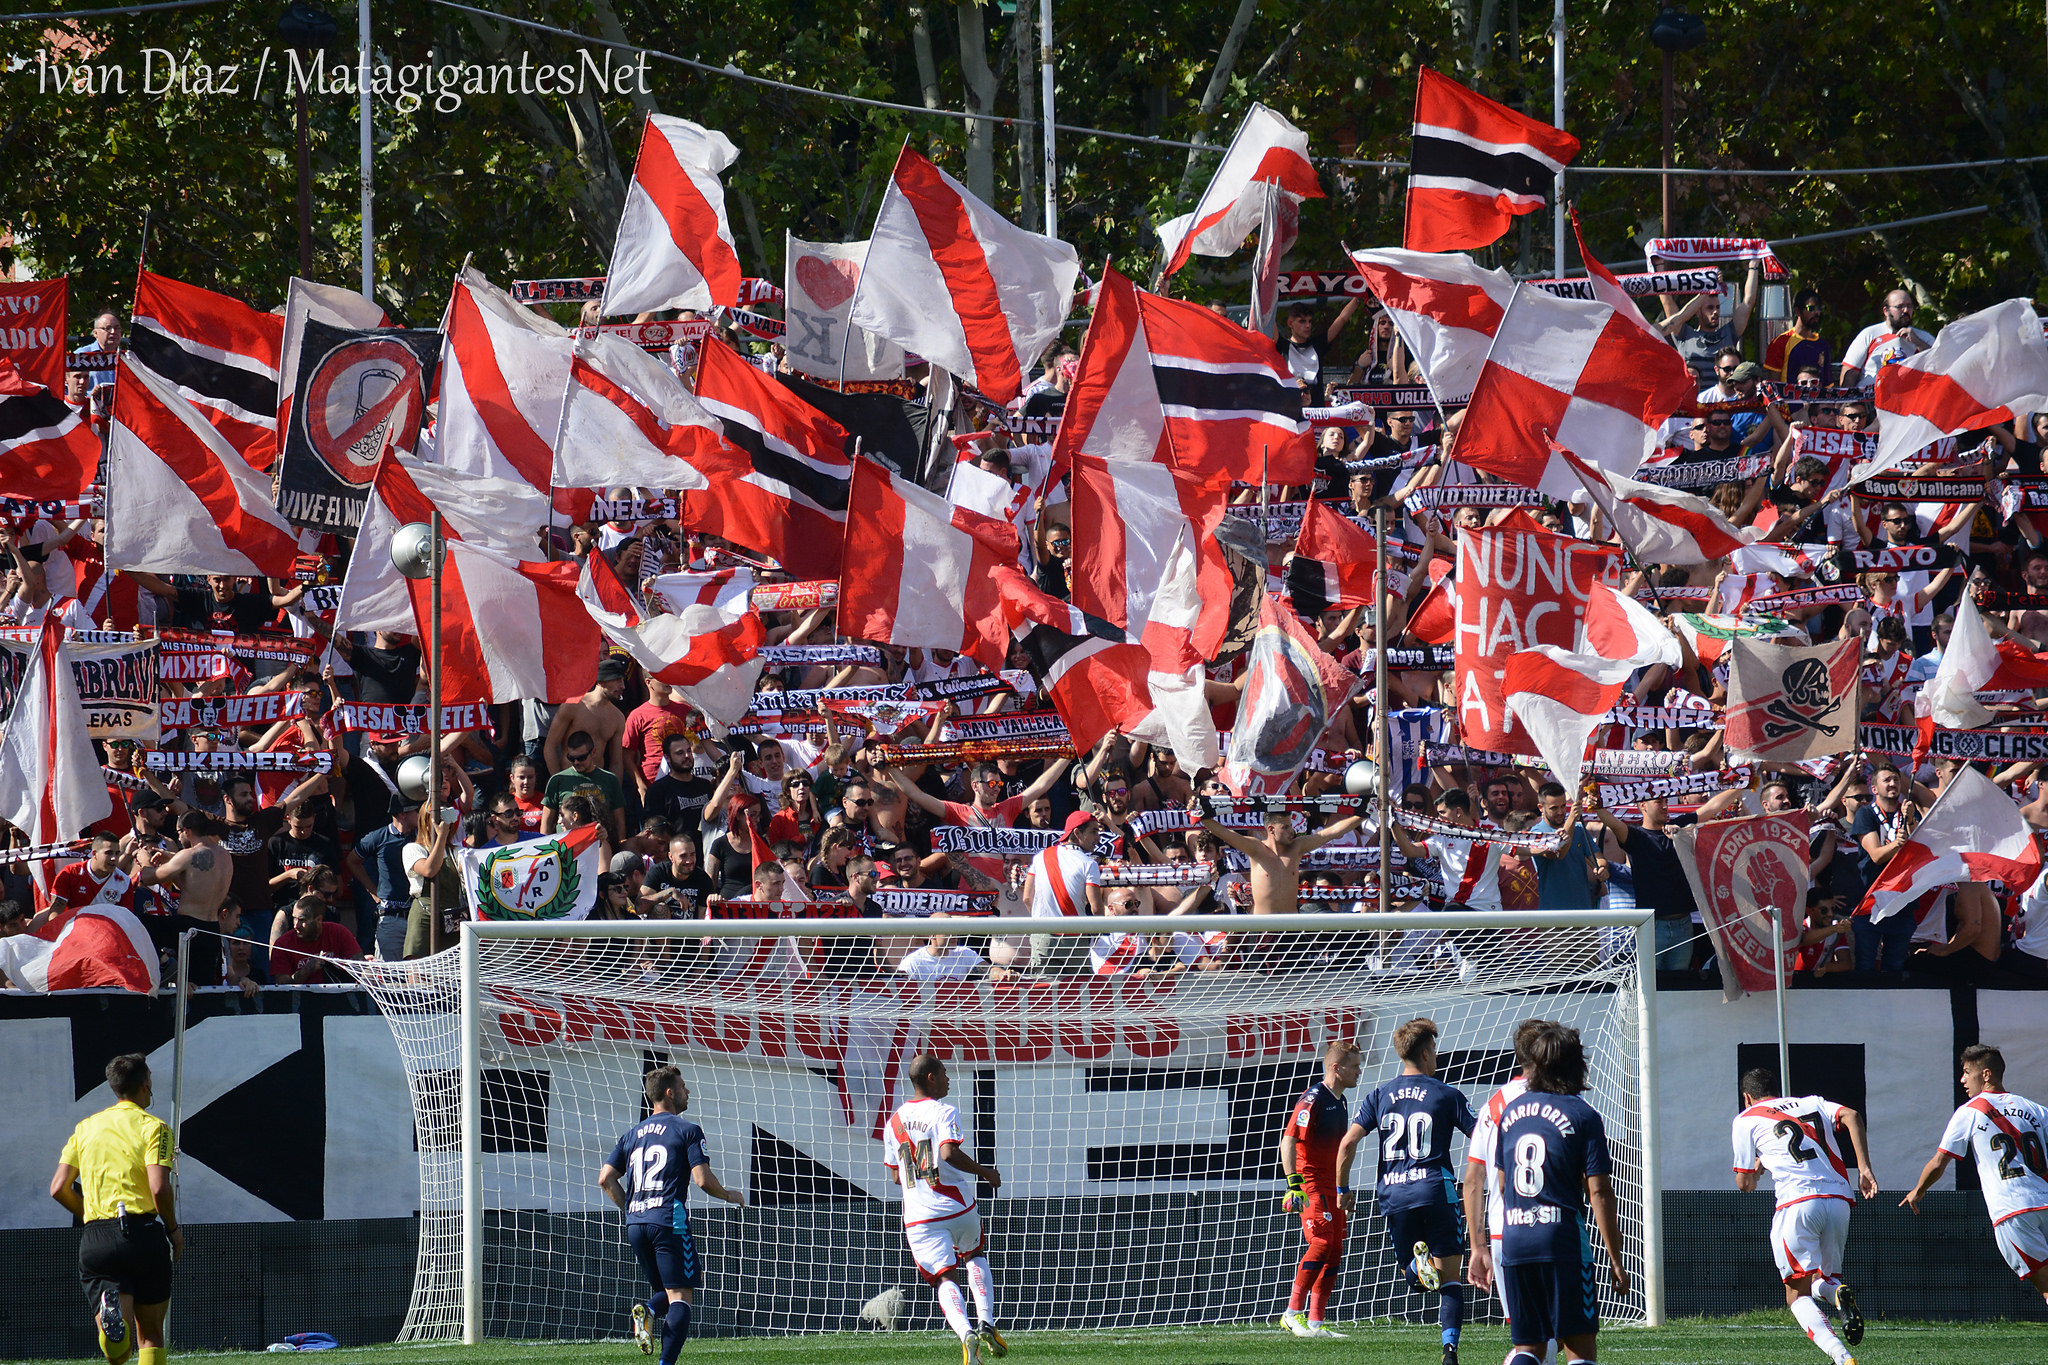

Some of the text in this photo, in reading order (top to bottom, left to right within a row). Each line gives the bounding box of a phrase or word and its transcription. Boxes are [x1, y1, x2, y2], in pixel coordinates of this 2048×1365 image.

[1654, 239, 1766, 254] RAYO VALLECANO
[1277, 275, 1368, 294] RAYO
[1652, 271, 1718, 293] CLASS
[1865, 479, 1984, 497] Rayo Vallecano
[281, 489, 325, 522] VIVE
[325, 495, 341, 525] EL
[1455, 527, 1622, 603] NUNCA
[1854, 547, 1937, 569] RAYO
[1386, 648, 1425, 666] Rayo
[935, 676, 1000, 696] Vallecano
[86, 710, 131, 729] EKAS
[226, 692, 278, 723] VETE
[333, 704, 396, 732] PRESA
[959, 720, 999, 738] RAYO
[1984, 735, 2048, 761] CLASS
[1720, 823, 1801, 869] ADRV 1924
[1725, 912, 1767, 961] KEEP
[1388, 1086, 1428, 1105] J.SEÑÉ
[1766, 1101, 1800, 1116] SANTI
[637, 1122, 668, 1139] RODRI
[1501, 1102, 1577, 1139] MARIO ORTIZ
[1976, 1105, 2042, 1133] E. VELÁZQUEZ
[1381, 1112, 1434, 1162] 20
[1773, 1110, 1830, 1163] 27
[629, 1144, 668, 1194] 12
[898, 1137, 940, 1190] 14
[1514, 1133, 1547, 1198] 8
[1990, 1131, 2048, 1182] 20
